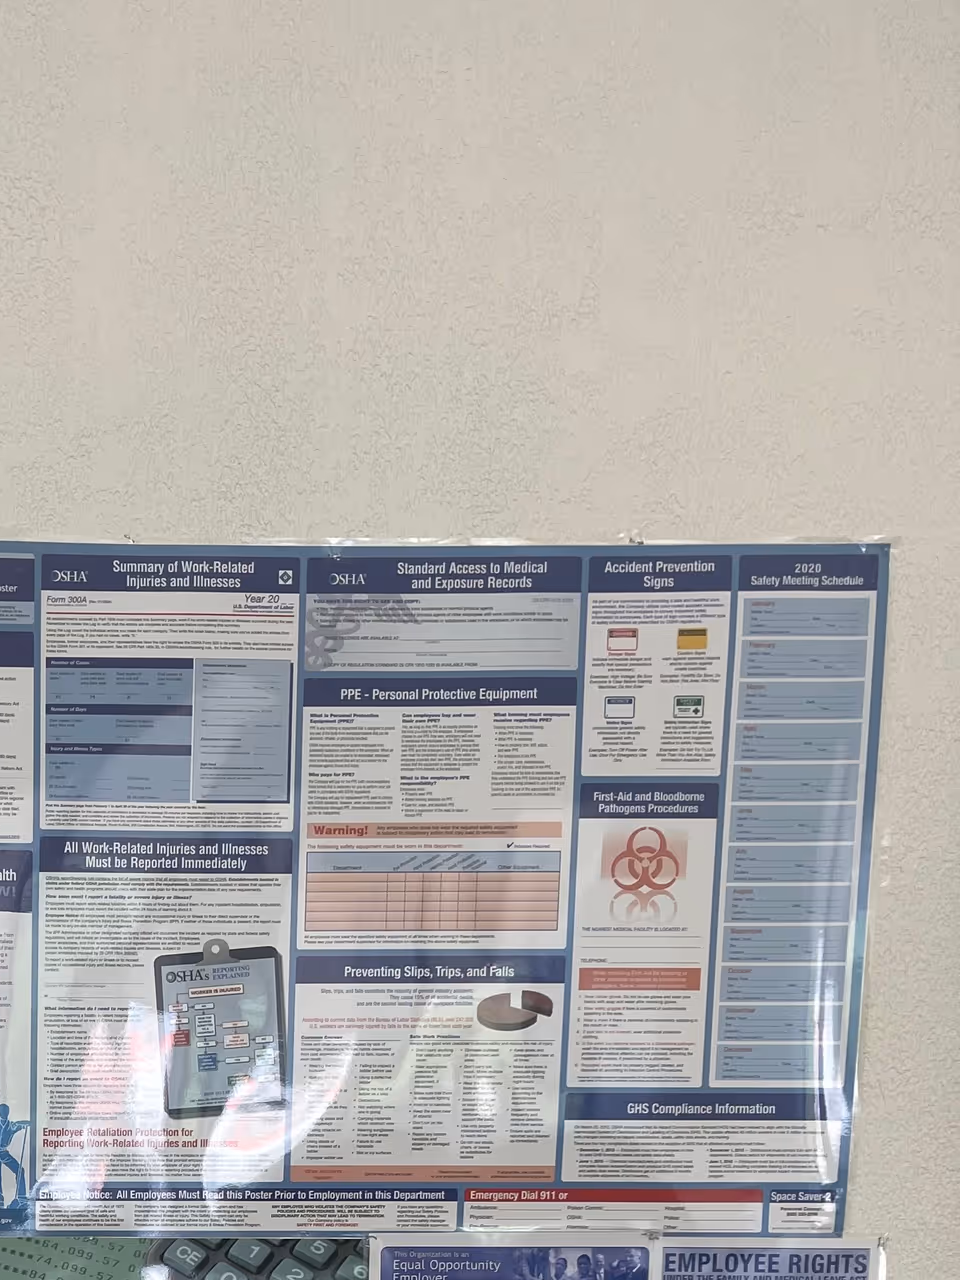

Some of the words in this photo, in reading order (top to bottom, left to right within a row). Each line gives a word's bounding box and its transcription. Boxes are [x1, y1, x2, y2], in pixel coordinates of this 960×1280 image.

[113, 560, 164, 575] Summary
[168, 561, 178, 572] of
[182, 561, 254, 573] Work-Related
[398, 562, 445, 574] Standard
[449, 562, 486, 574] Access
[491, 563, 500, 573] to
[504, 562, 547, 573] Medical
[605, 562, 652, 572] Accident
[656, 561, 714, 572] Prevention
[795, 564, 821, 572] 2020
[127, 574, 166, 588] Injuries
[170, 576, 189, 586] and
[194, 576, 240, 587] Illnesses
[412, 577, 431, 588] and
[436, 577, 484, 588] Exposure
[488, 577, 532, 588] Records
[644, 576, 674, 589] Signs
[751, 576, 780, 586] Safety
[782, 576, 819, 586] Meeting
[822, 576, 863, 585] Schedule
[341, 689, 361, 699] PPE
[373, 689, 418, 700] Personal
[422, 689, 476, 699] Protective
[480, 688, 537, 701] Equipment
[594, 792, 632, 801] First-Aid
[635, 792, 651, 801] and
[654, 792, 704, 801] Bloodborne
[599, 804, 645, 814] Pathogens
[648, 804, 698, 812] Procedures
[314, 826, 368, 836] Warning!
[64, 842, 78, 855] All
[82, 842, 152, 855] Work-Related
[157, 842, 195, 857] Injuries
[199, 843, 219, 855] and
[221, 843, 268, 855] Illnesses
[85, 856, 111, 869] Must
[115, 857, 126, 869] be
[131, 857, 177, 871] Reported
[182, 858, 246, 872] Immediately
[345, 966, 400, 979] Preventing
[404, 966, 432, 978] Slips,
[435, 966, 464, 978] Trips,
[467, 966, 486, 976] and
[490, 966, 514, 976] Falls
[628, 1103, 649, 1113] GHS
[652, 1104, 712, 1114] Compliance
[716, 1104, 775, 1114] Information
[469, 1191, 519, 1202] Emergency
[521, 1191, 538, 1202] Dial
[540, 1191, 555, 1202] 911
[557, 1193, 569, 1202] or
[394, 1260, 425, 1271] Equal
[430, 1260, 500, 1272] Opportunity
[664, 1253, 780, 1272] EMPLOYEE
[789, 1254, 867, 1273] RIGHTS
